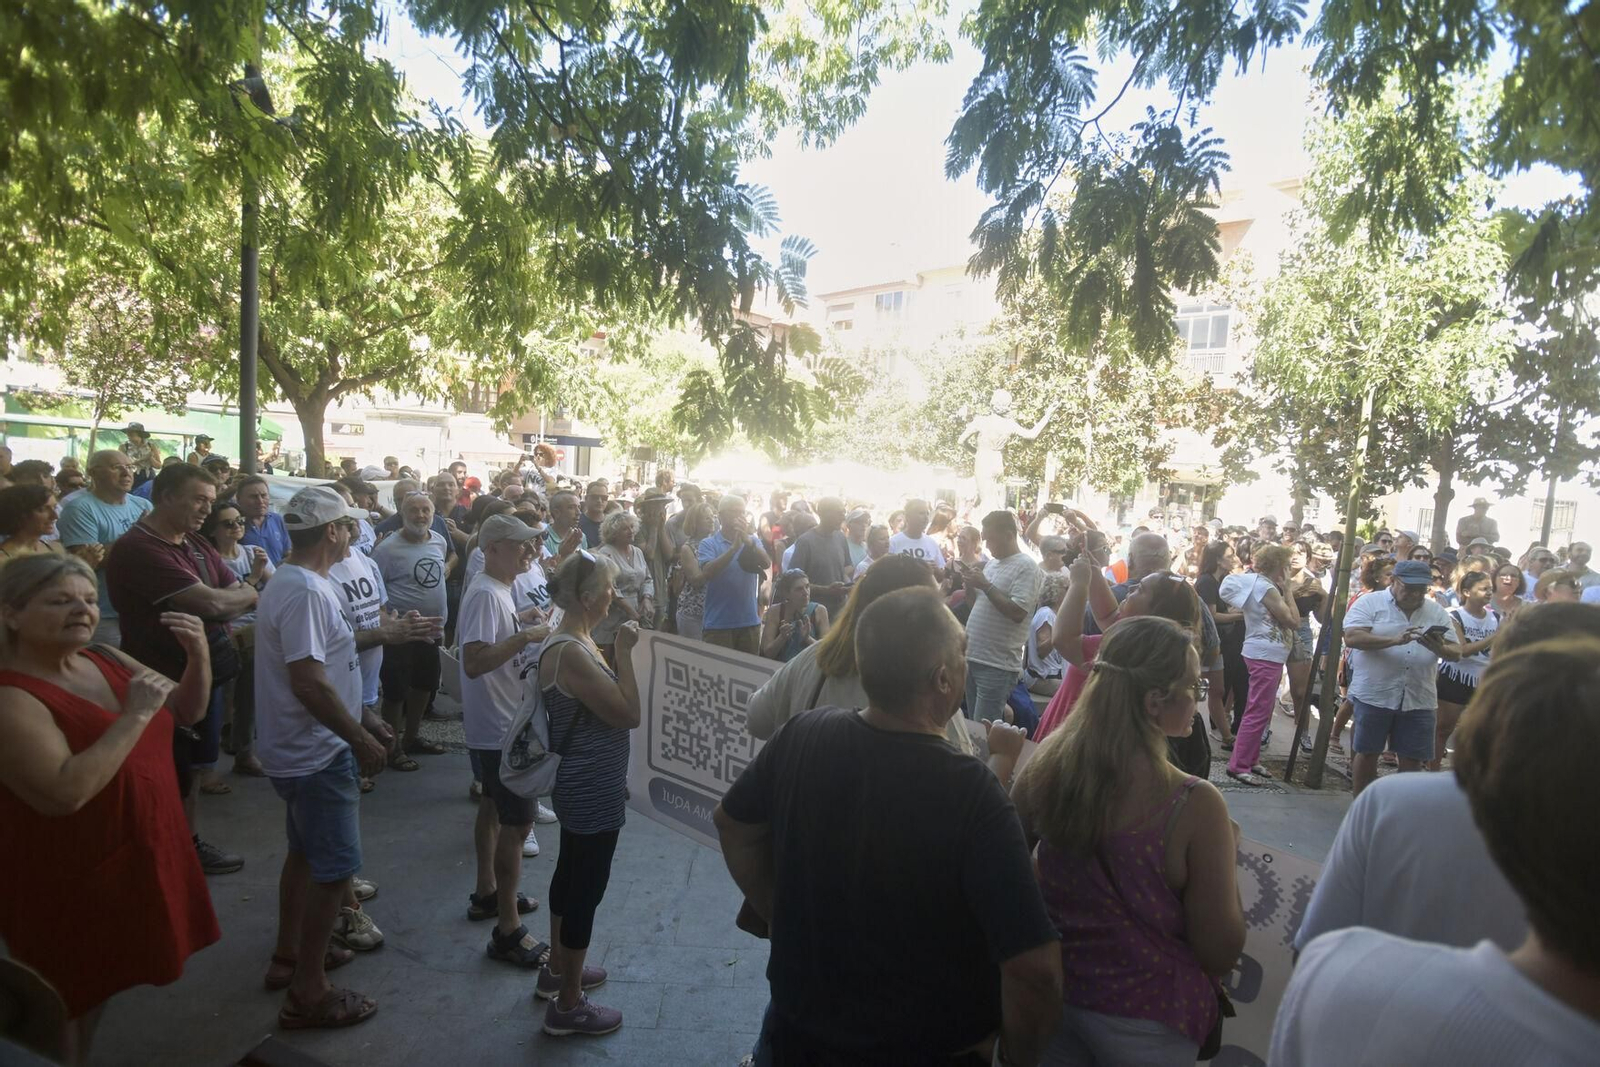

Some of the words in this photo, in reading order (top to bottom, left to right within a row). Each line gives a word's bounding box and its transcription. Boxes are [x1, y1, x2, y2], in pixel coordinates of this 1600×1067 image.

[903, 548, 925, 559] NO
[342, 577, 373, 603] NO
[526, 584, 550, 606] NO
